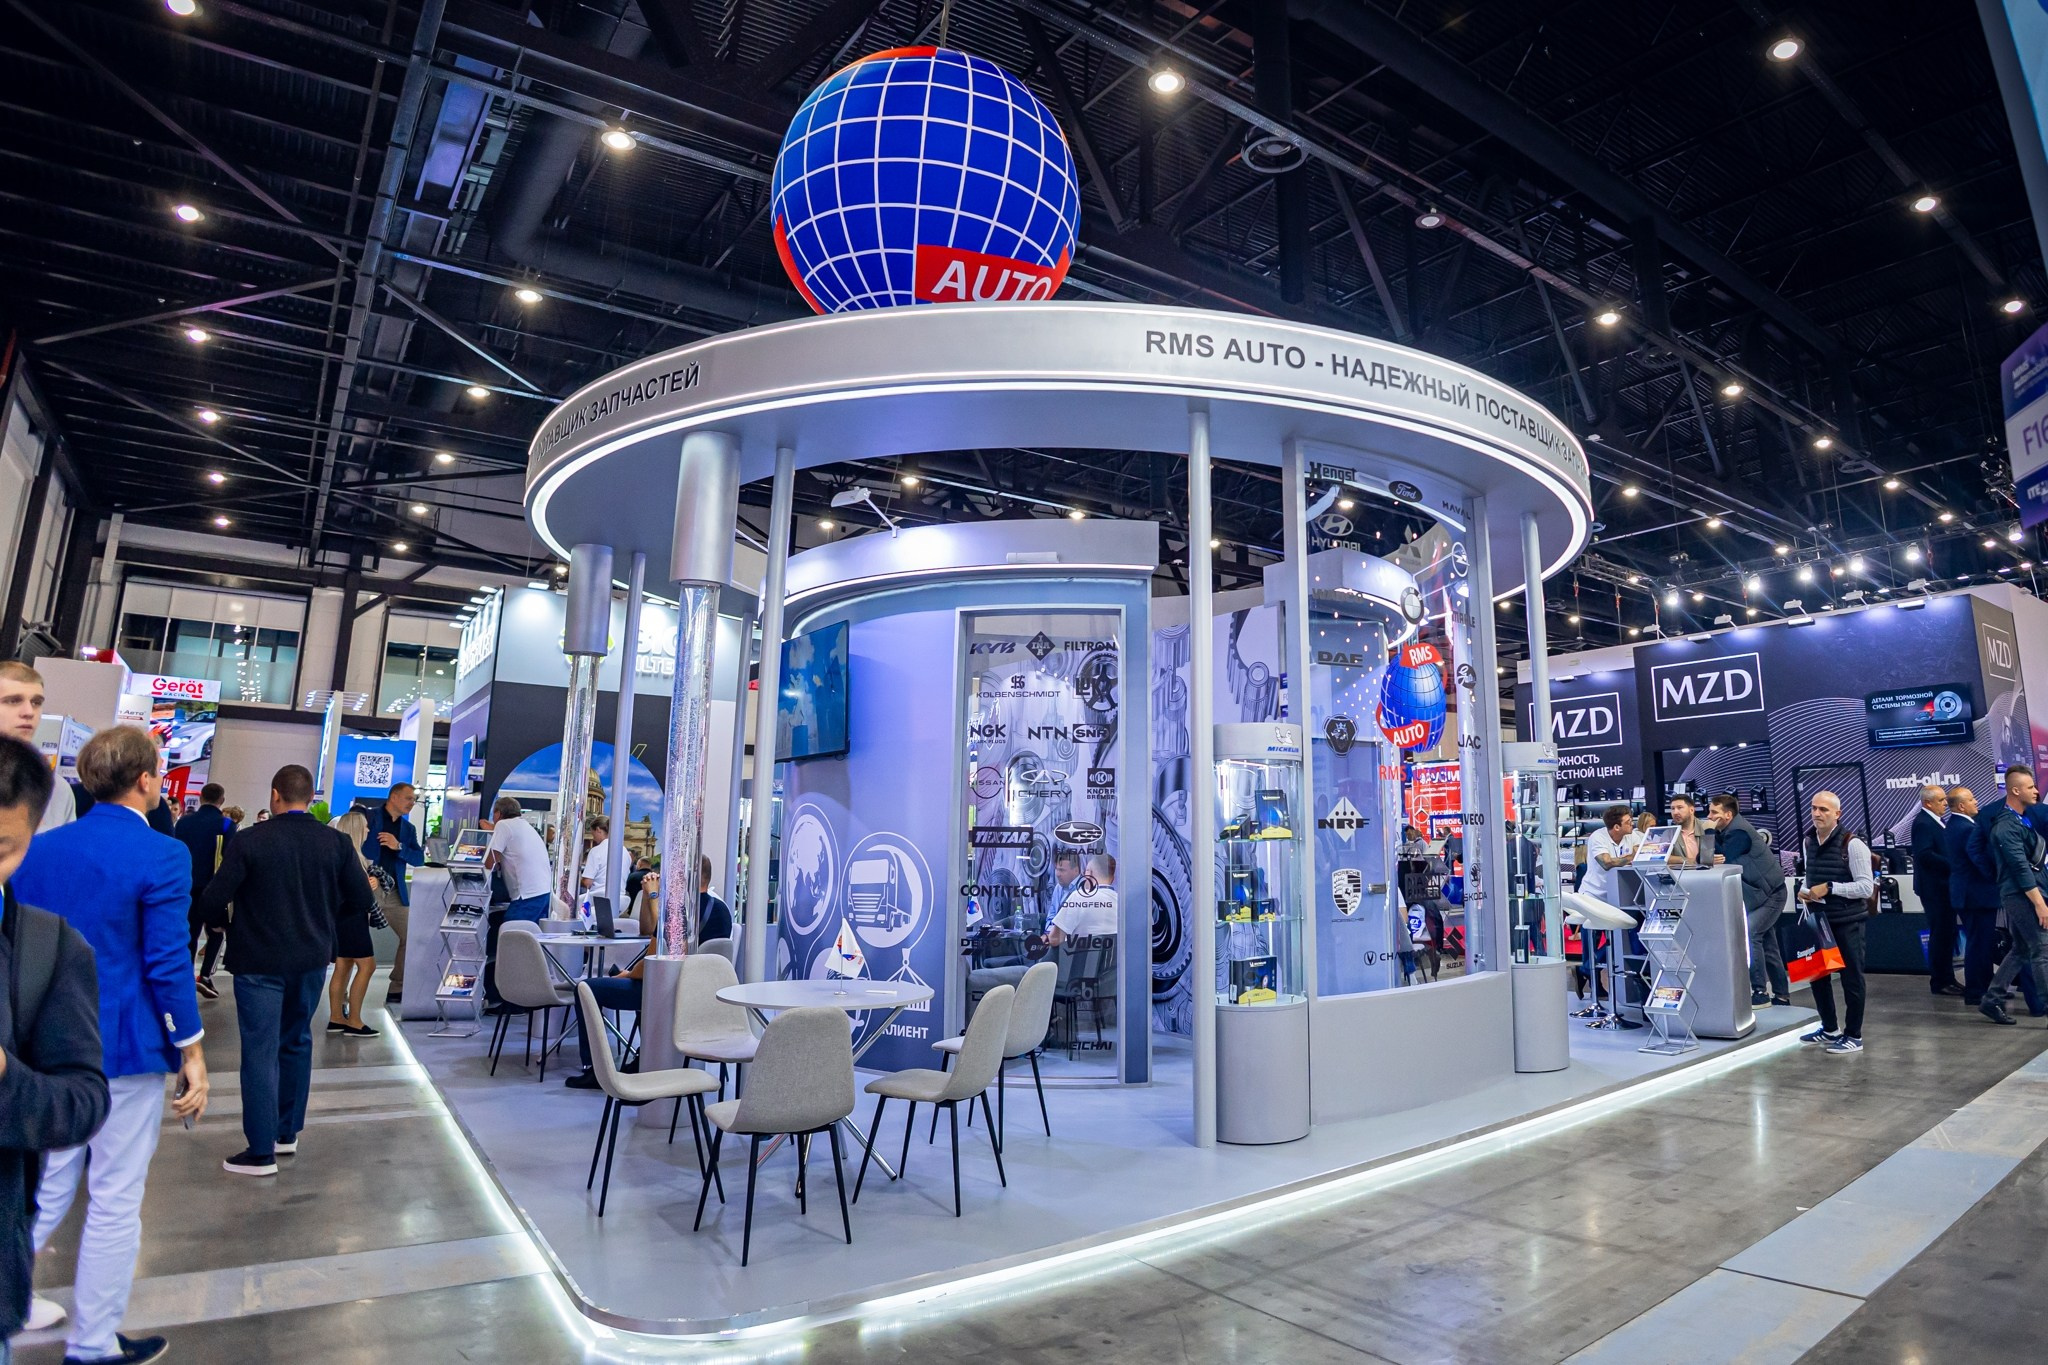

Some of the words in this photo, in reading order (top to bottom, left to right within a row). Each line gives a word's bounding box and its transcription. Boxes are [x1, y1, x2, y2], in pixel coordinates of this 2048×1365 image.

[931, 259, 1052, 301] AUTO
[590, 361, 701, 422] ЗАПЧАСТЕЙ
[1145, 330, 1214, 358] RMS
[1224, 338, 1306, 369] AUTO
[1331, 353, 1471, 410] НАДЕЖНЫЙ
[1476, 393, 1561, 456] ПОСТАВЩИК
[1309, 461, 1357, 484] Hengst
[1395, 483, 1417, 499] Ford
[1442, 500, 1471, 520] HAVAL
[970, 642, 1016, 655] KYB
[1064, 641, 1119, 652] FILTRON
[1987, 636, 2012, 669] MZD
[1317, 650, 1363, 664] DAF
[1408, 645, 1433, 667] RMS
[152, 678, 204, 694] Gerät
[1662, 668, 1753, 709] MZD
[1895, 691, 1934, 701] ТОРМОЗНОЙ
[1872, 702, 1901, 710] СИСТЕМЫ
[970, 724, 1006, 738] NGK
[1028, 726, 1068, 741] NTN
[1075, 729, 1108, 738] SNR
[1393, 723, 1425, 746] AUTO
[1457, 734, 1481, 749] JAC
[1558, 754, 1600, 767] ЖНОСТЬ
[1597, 765, 1624, 778] ЦЕНЕ
[1886, 771, 1960, 789] mzd-oil.ru
[1018, 790, 1073, 798] CHERY
[1318, 818, 1370, 829] NRF
[1055, 848, 1104, 856] SUBARU
[960, 884, 1040, 898] CONTITECH
[1066, 934, 1113, 949] Valeo
[1070, 1041, 1113, 1051] EICHAI
